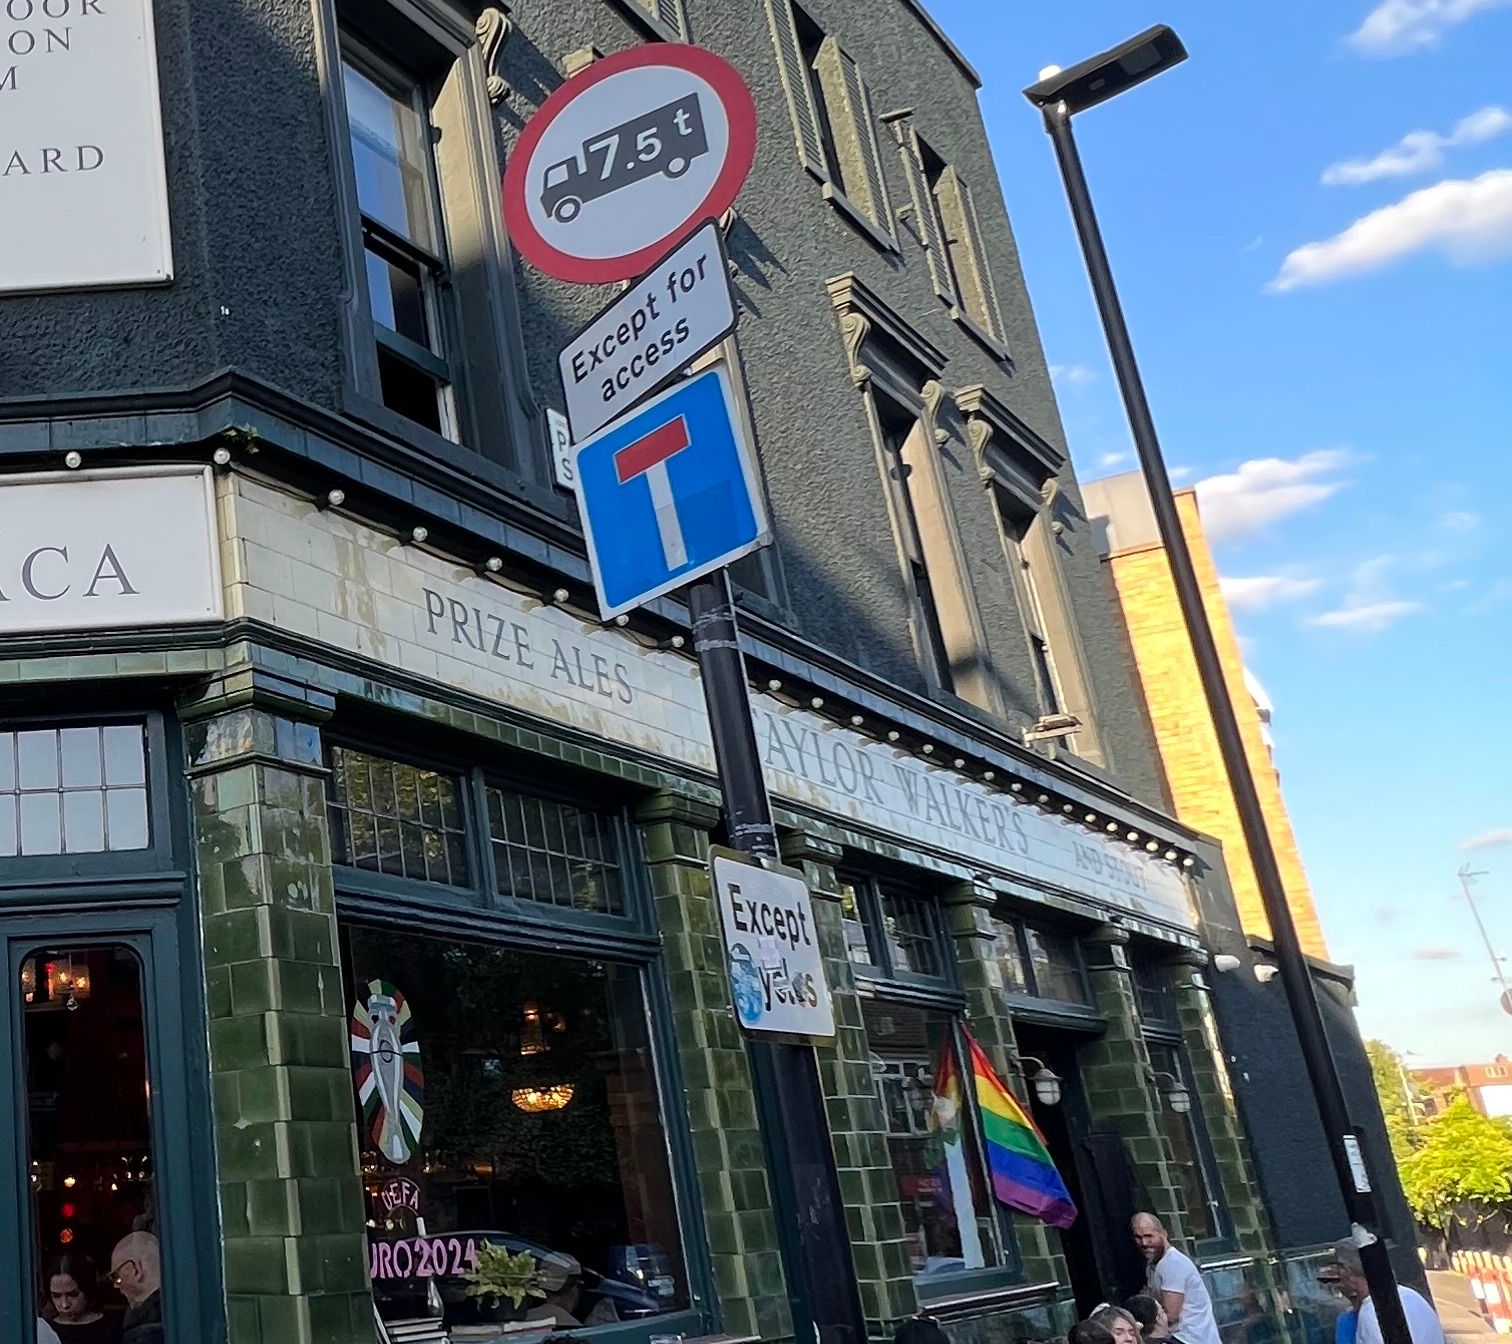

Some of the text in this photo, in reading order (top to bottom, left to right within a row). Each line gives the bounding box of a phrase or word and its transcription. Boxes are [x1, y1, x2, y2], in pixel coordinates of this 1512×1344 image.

[589, 107, 693, 182] 7.5 t
[571, 249, 709, 386] Except for
[601, 316, 691, 403] access
[422, 587, 535, 670] PRIZE
[550, 639, 633, 705] ALES
[753, 708, 886, 806] AYLOR
[892, 763, 1029, 856] WALKER'S
[728, 882, 811, 952] Except
[381, 1181, 419, 1211] UEFA
